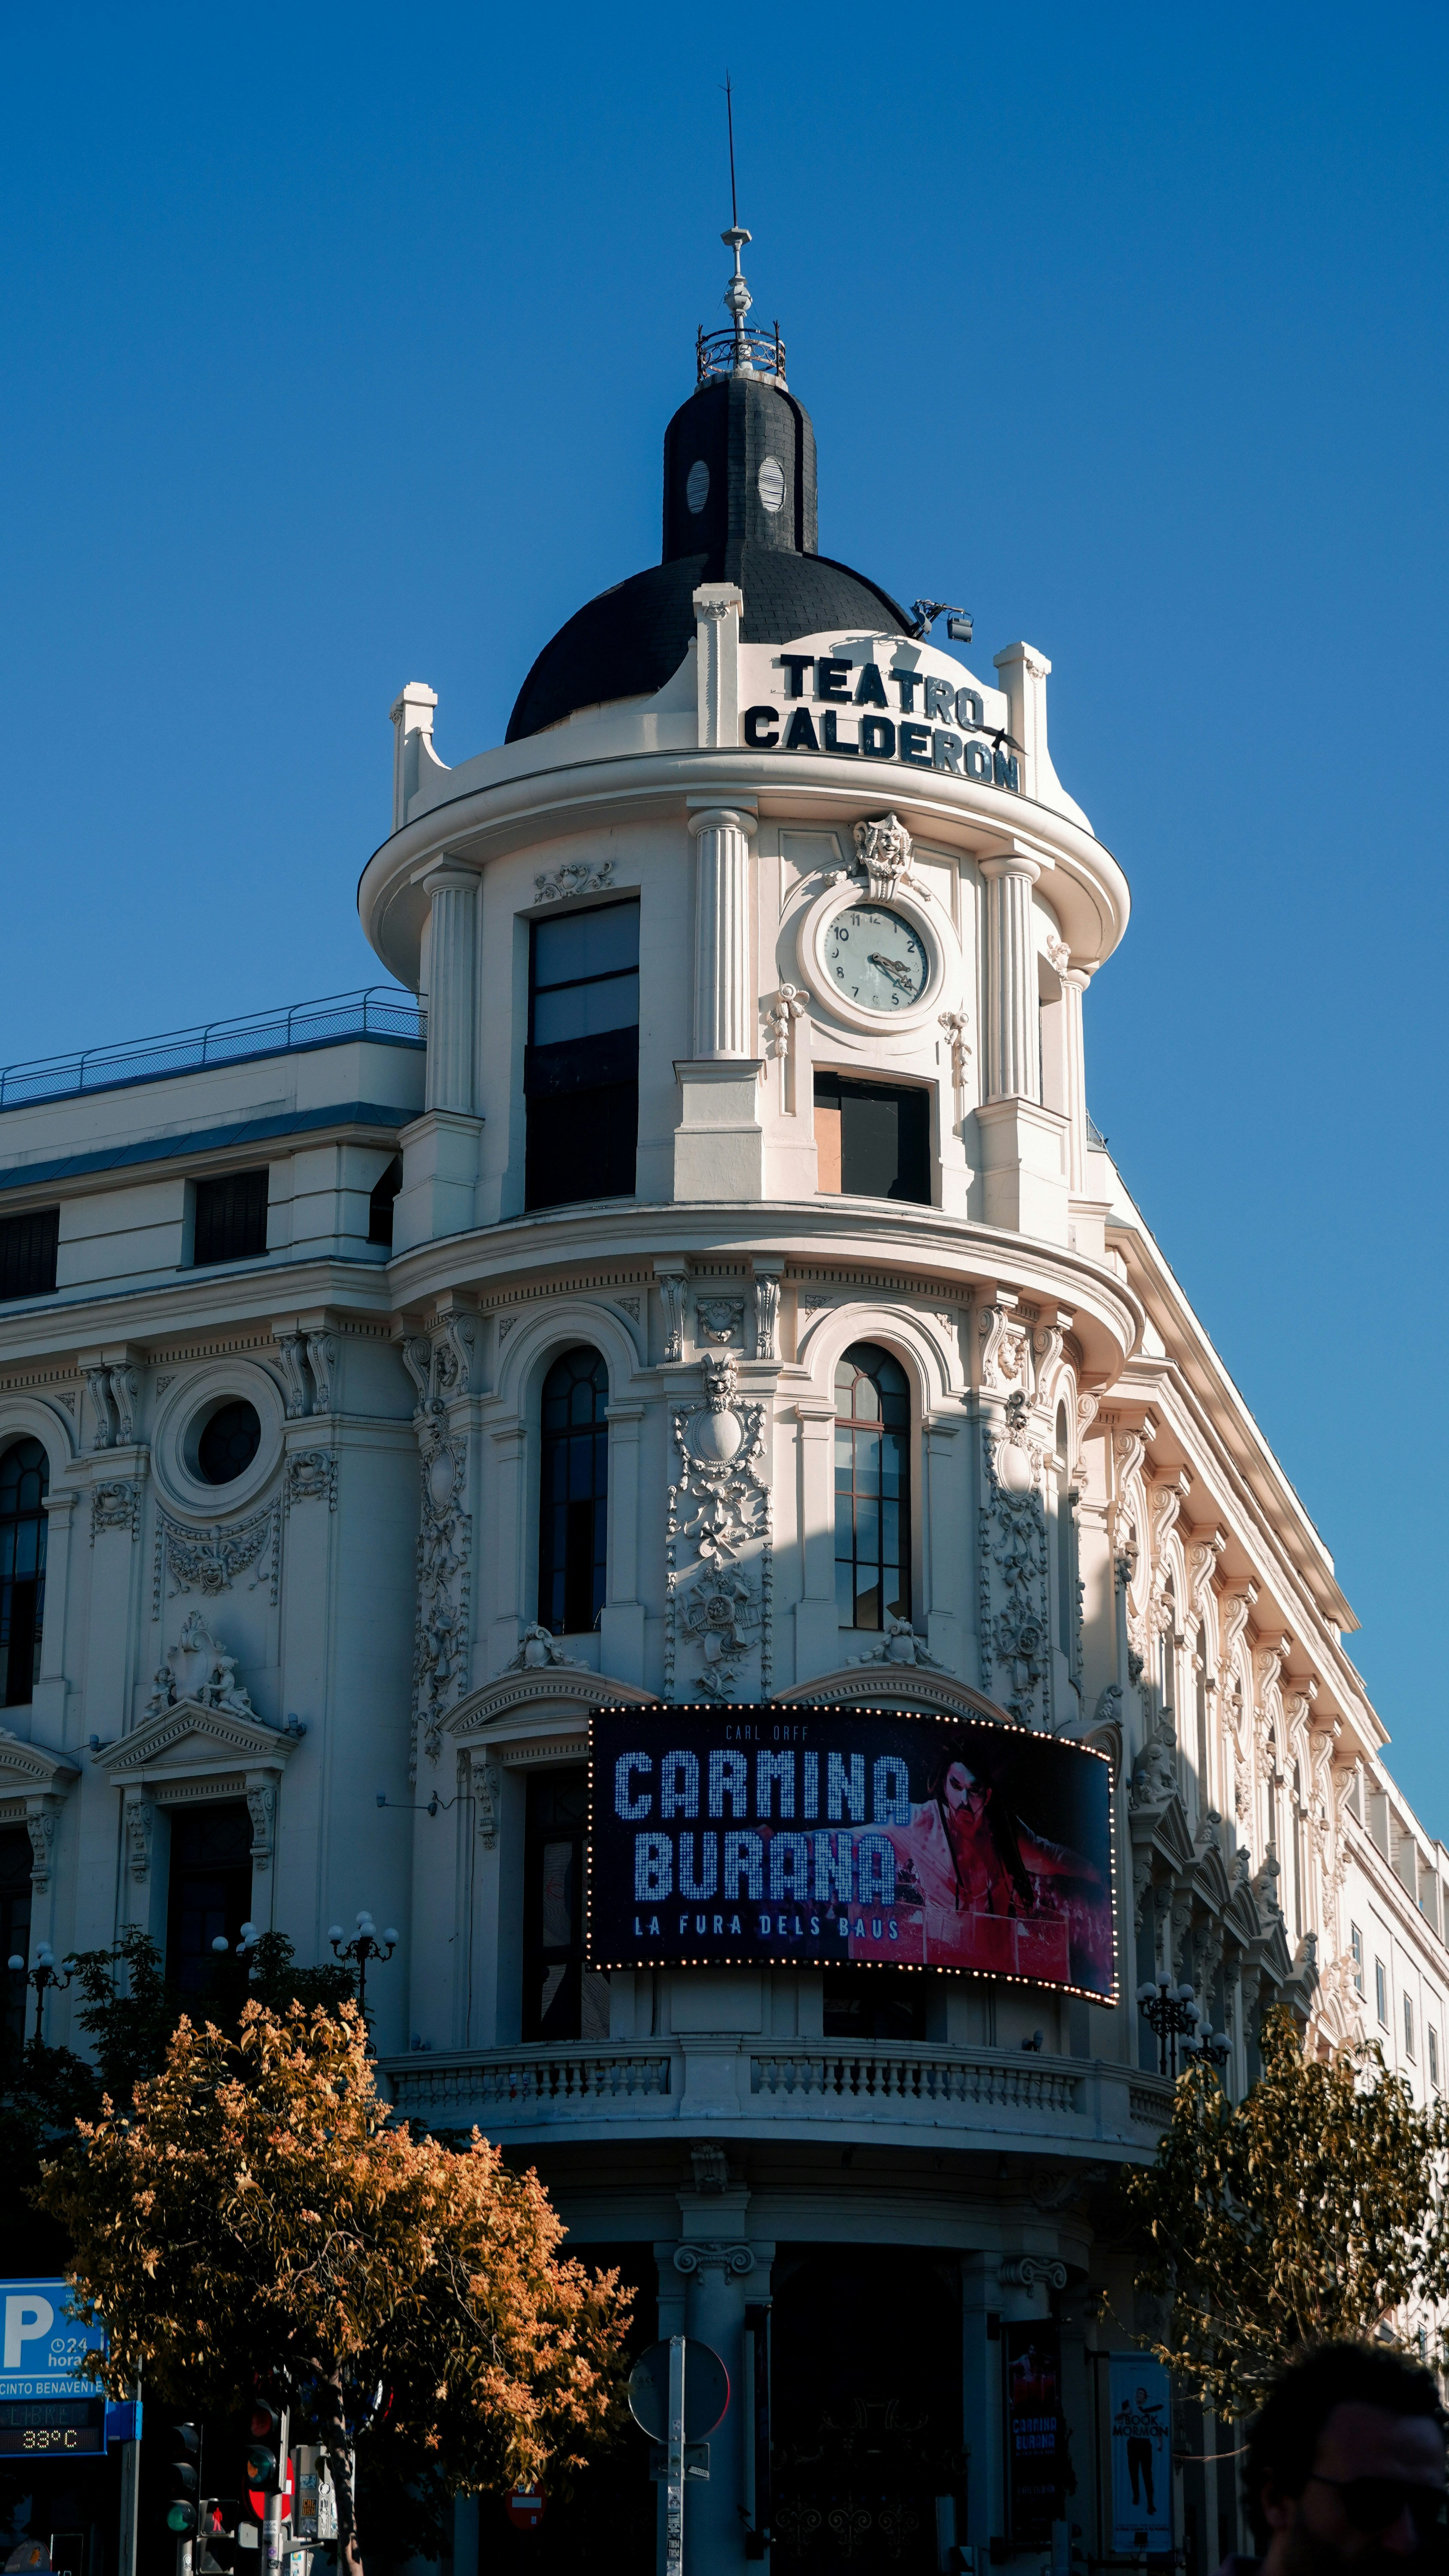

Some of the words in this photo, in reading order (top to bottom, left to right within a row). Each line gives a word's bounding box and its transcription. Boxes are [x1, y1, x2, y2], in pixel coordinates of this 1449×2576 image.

[780, 653, 984, 732] TEATRO
[744, 705, 1019, 793] CALDERON
[850, 912, 861, 927] 11
[834, 926, 849, 942] 10
[906, 940, 915, 953] 2
[836, 966, 845, 979] 8
[851, 986, 859, 997] 7
[891, 993, 900, 1005] 5
[726, 1725, 761, 1740] CARL
[773, 1725, 808, 1741] ORFF
[614, 1749, 911, 1826] CARMINA
[634, 1830, 897, 1905] BURANA
[634, 1915, 660, 1935] LA
[679, 1915, 742, 1934] FURA
[760, 1915, 820, 1935] DELS
[839, 1917, 898, 1940] BAUS
[3, 2295, 54, 2368] P
[67, 2337, 88, 2353] 24
[48, 2353, 84, 2367] hora
[36, 2380, 103, 2394] BENAVENTE
[1013, 2417, 1057, 2434] CARMINA
[1125, 2415, 1158, 2425] BOOK
[1112, 2425, 1168, 2436] MORMON
[1016, 2433, 1055, 2450] BURANA
